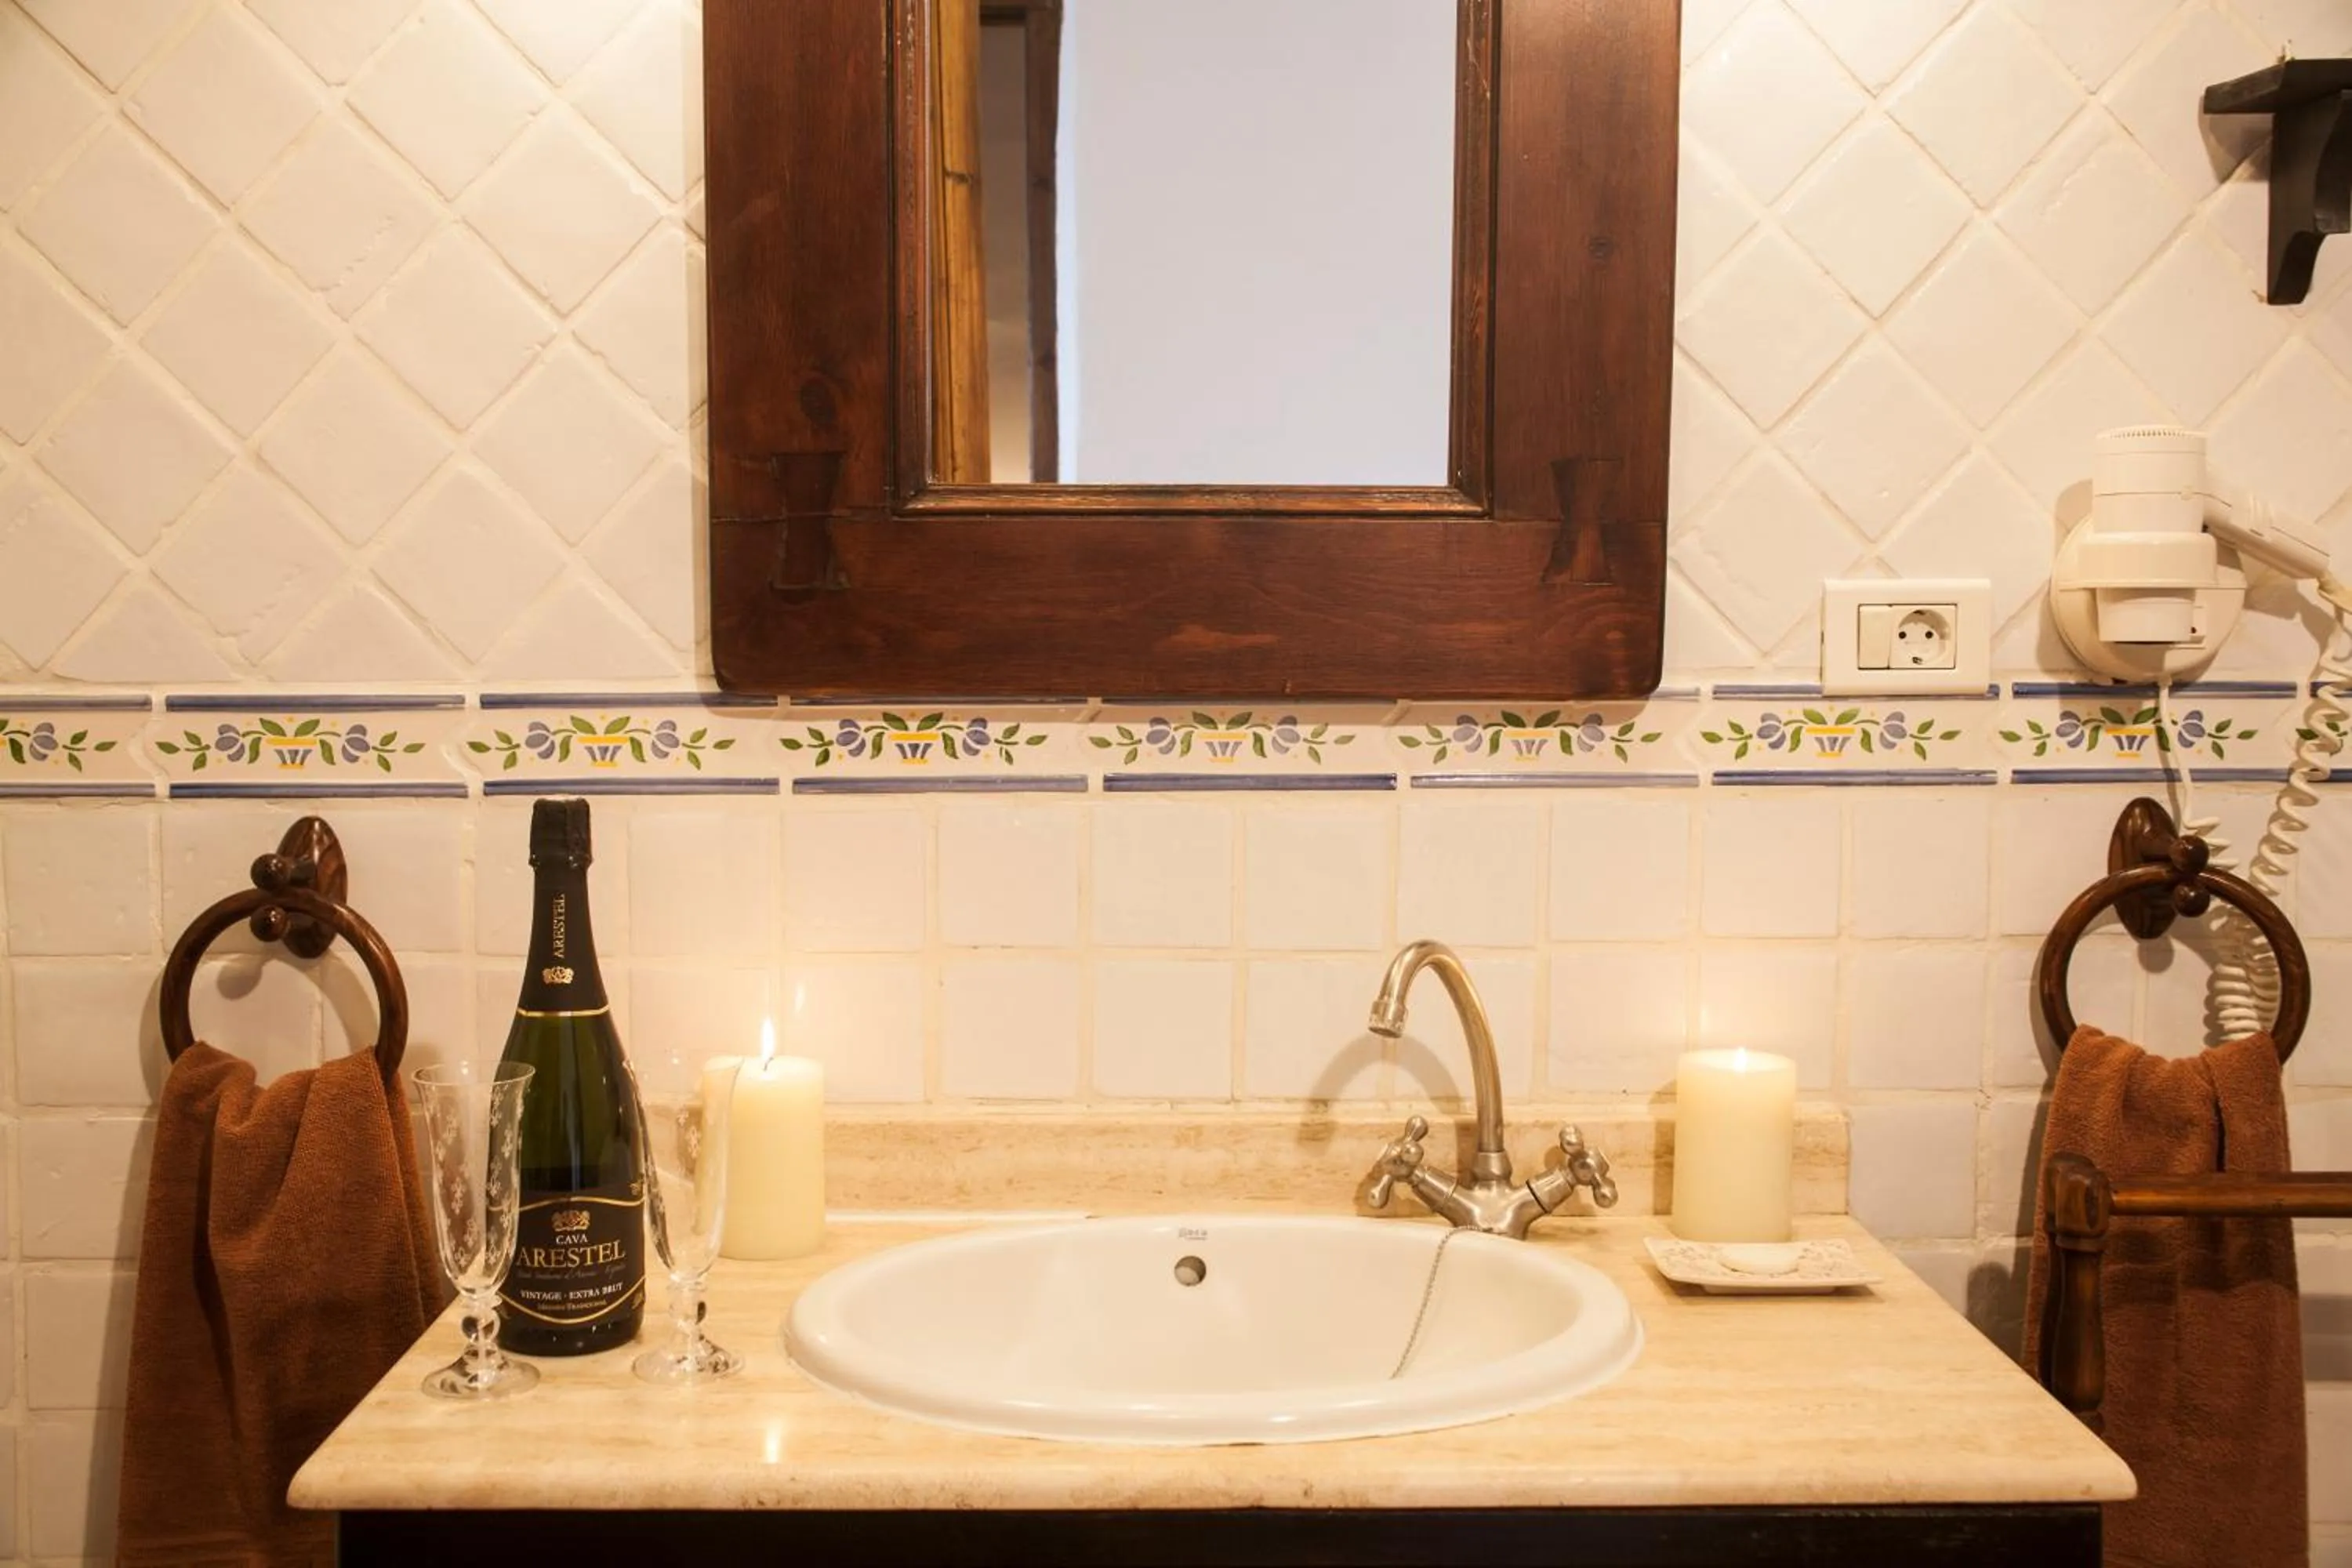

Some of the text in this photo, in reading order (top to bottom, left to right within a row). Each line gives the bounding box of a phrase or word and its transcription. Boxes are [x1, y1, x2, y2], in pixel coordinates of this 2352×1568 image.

[552, 892, 565, 959] ARESTEL
[556, 1233, 588, 1245] CAVA
[516, 1239, 626, 1268] ARESTEL
[520, 1282, 623, 1301] VINTAGE EXTRA BRUT
